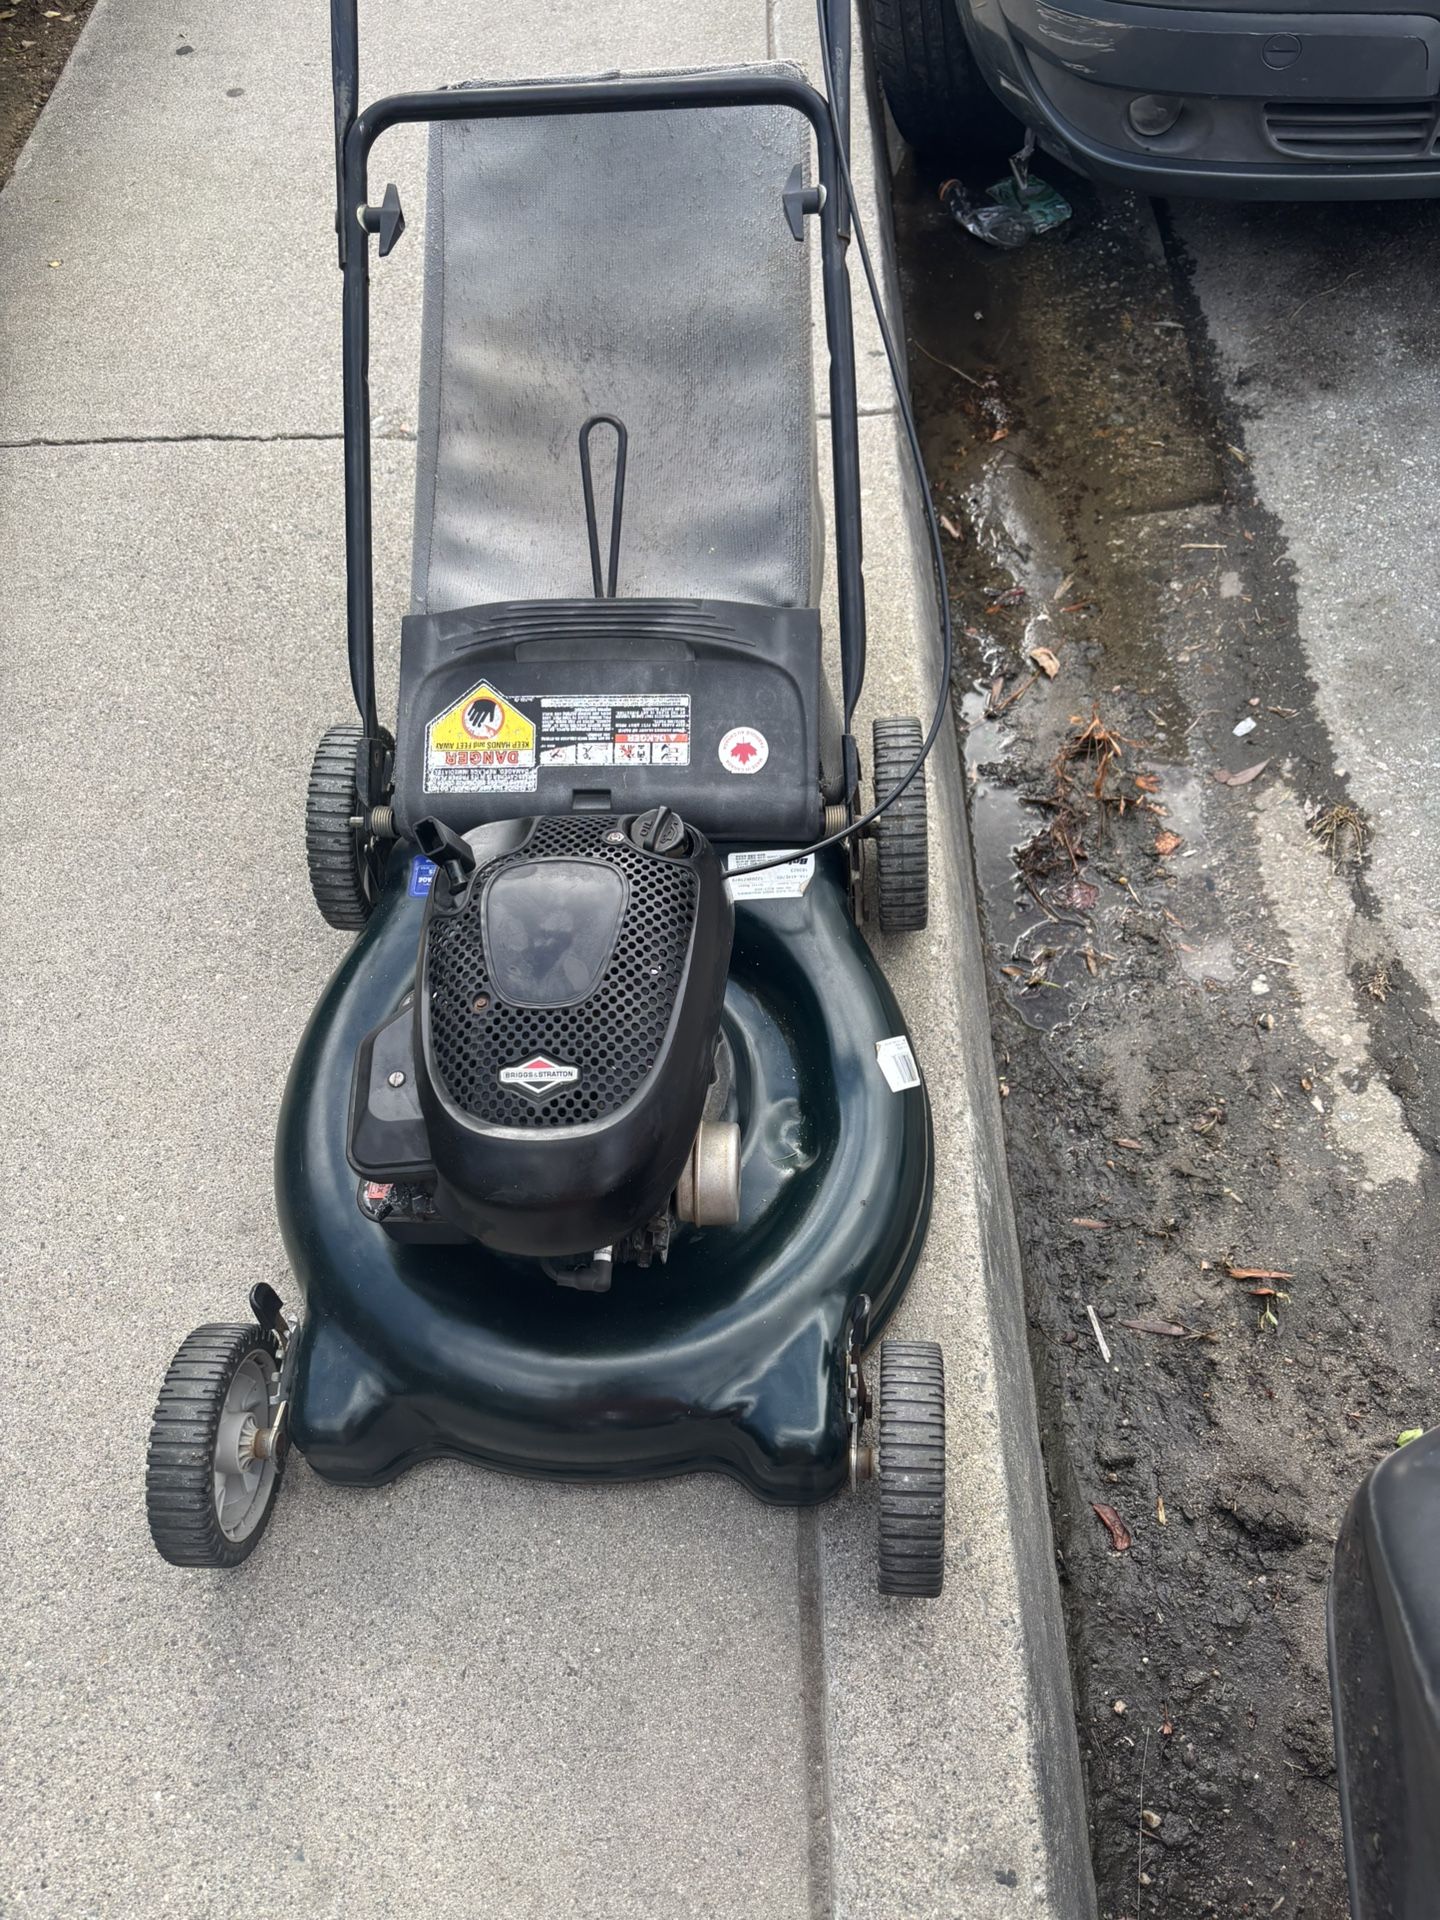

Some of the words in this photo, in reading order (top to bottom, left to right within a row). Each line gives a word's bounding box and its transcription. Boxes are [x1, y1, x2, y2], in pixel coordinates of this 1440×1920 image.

[435, 742, 455, 750] AWAY
[472, 741, 486, 749] and
[486, 741, 511, 749] HANDS
[512, 741, 530, 750] KEEP
[445, 751, 519, 765] DANGER
[640, 820, 654, 837] OIL
